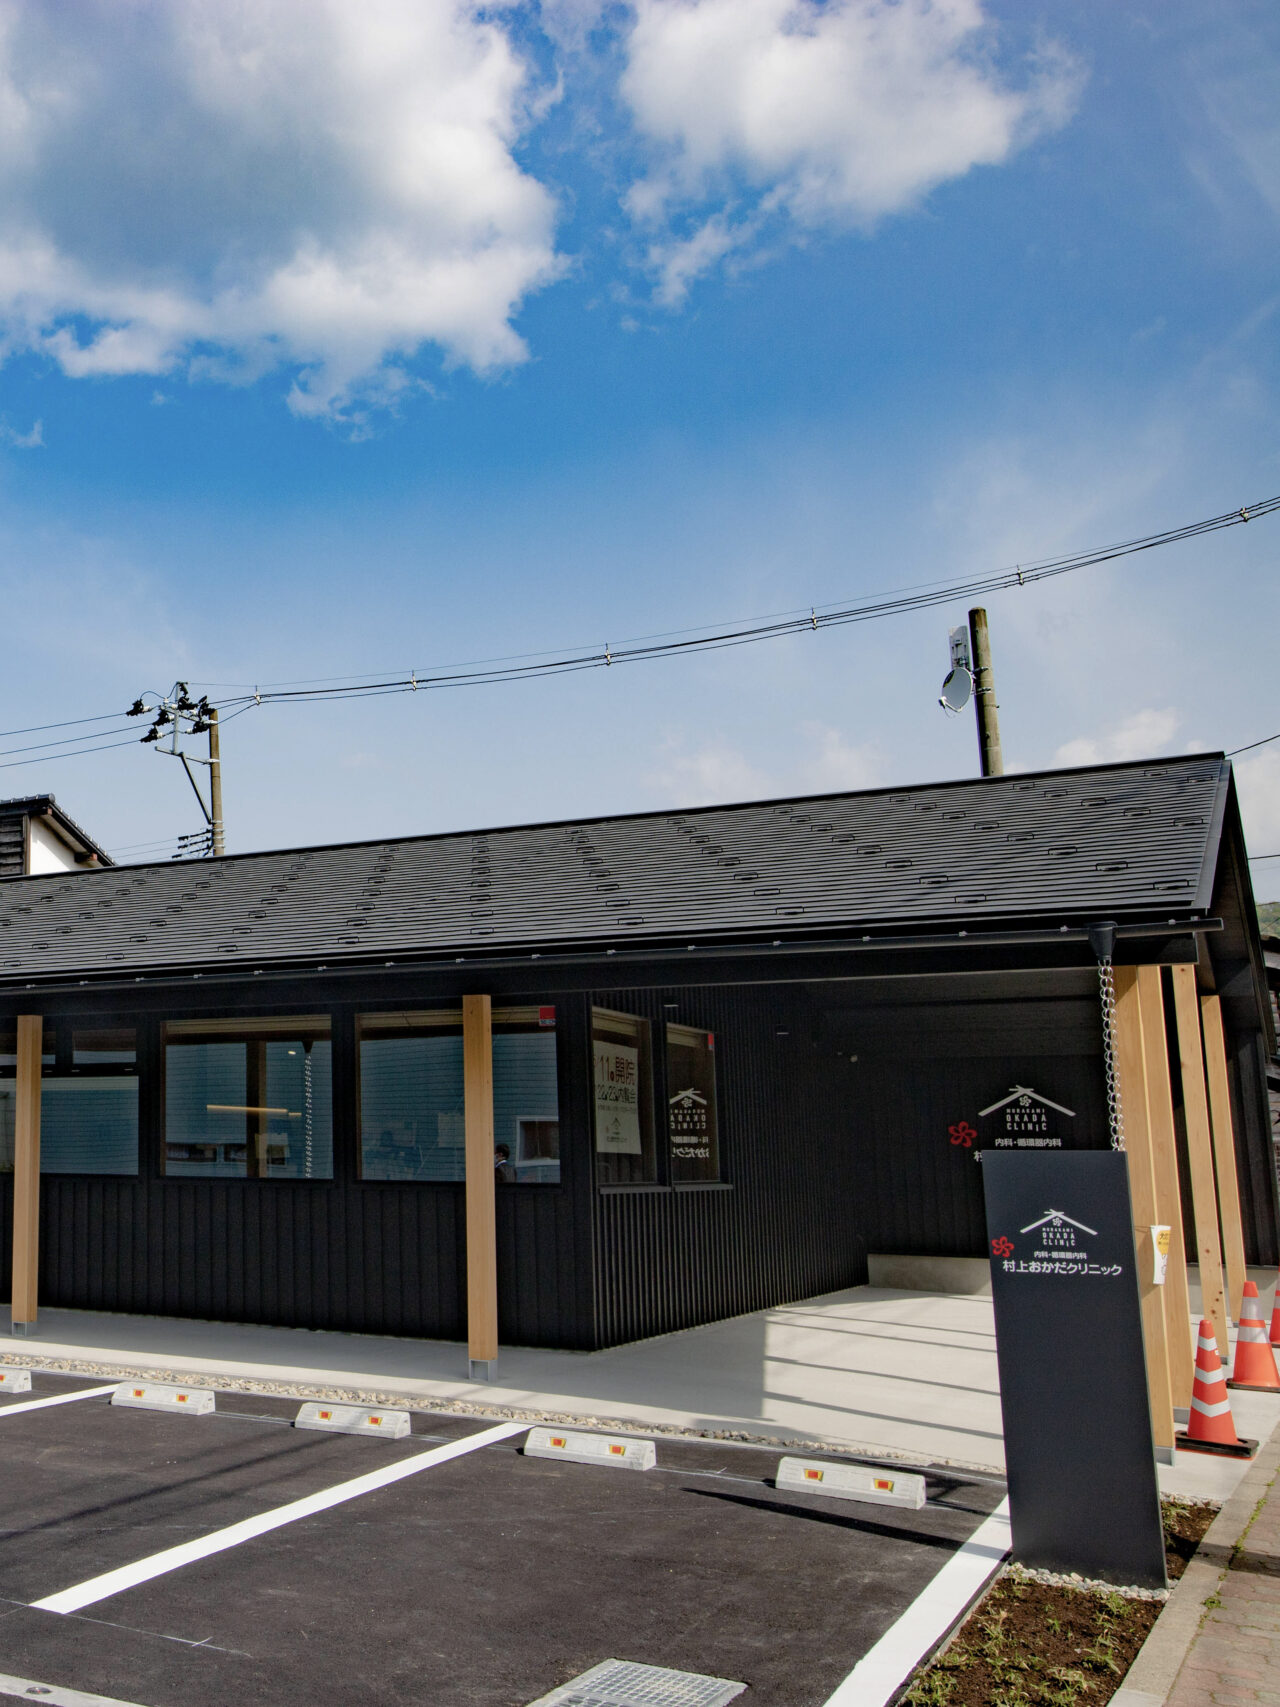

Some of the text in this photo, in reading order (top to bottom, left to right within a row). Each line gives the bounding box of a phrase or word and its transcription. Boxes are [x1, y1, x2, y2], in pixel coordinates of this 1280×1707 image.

[1006, 1114, 1047, 1122] OKADA
[1006, 1123, 1047, 1132] CLINIC
[1043, 1239, 1076, 1247] CLINIC
[1002, 1260, 1123, 1276] 村上おかだクリニック
